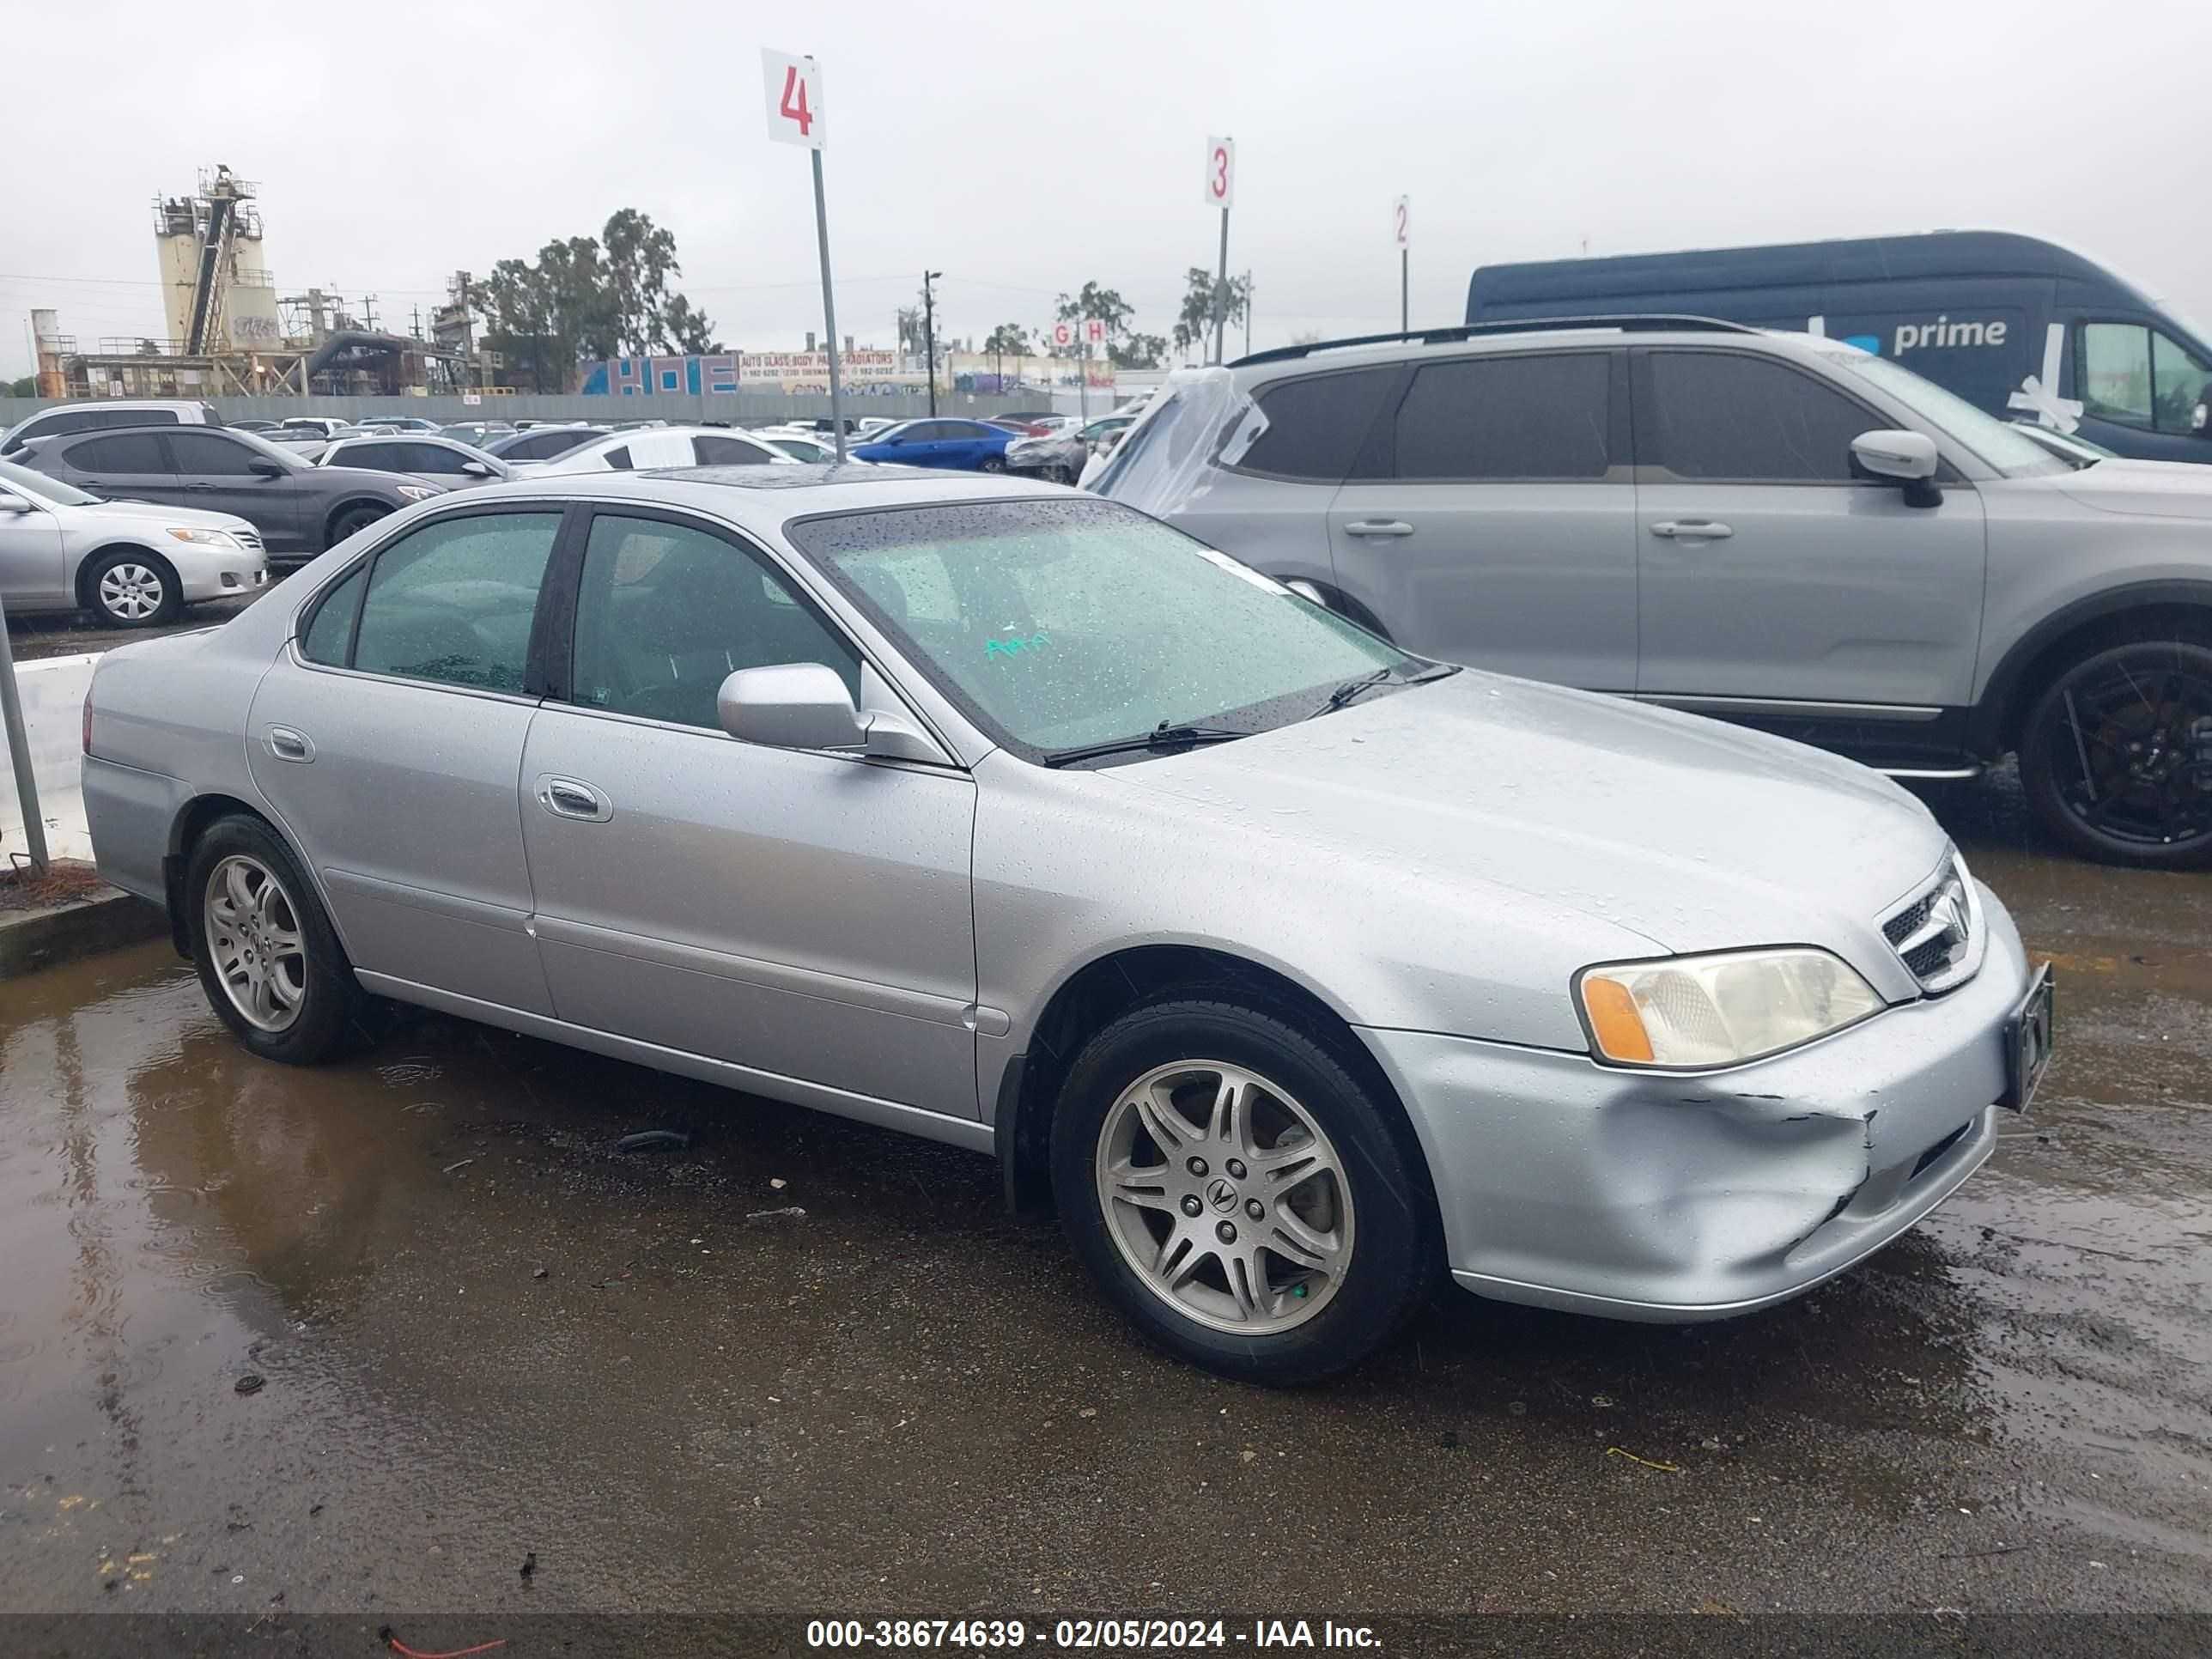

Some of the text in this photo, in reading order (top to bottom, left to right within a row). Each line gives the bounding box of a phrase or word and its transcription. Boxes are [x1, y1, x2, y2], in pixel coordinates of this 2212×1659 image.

[781, 66, 812, 136] 4
[1212, 148, 1227, 198] 3
[1397, 204, 1407, 242] 2
[1056, 325, 1068, 343] G
[1089, 322, 1101, 341] H
[1894, 315, 2007, 356] prime
[742, 356, 761, 367] AUTO
